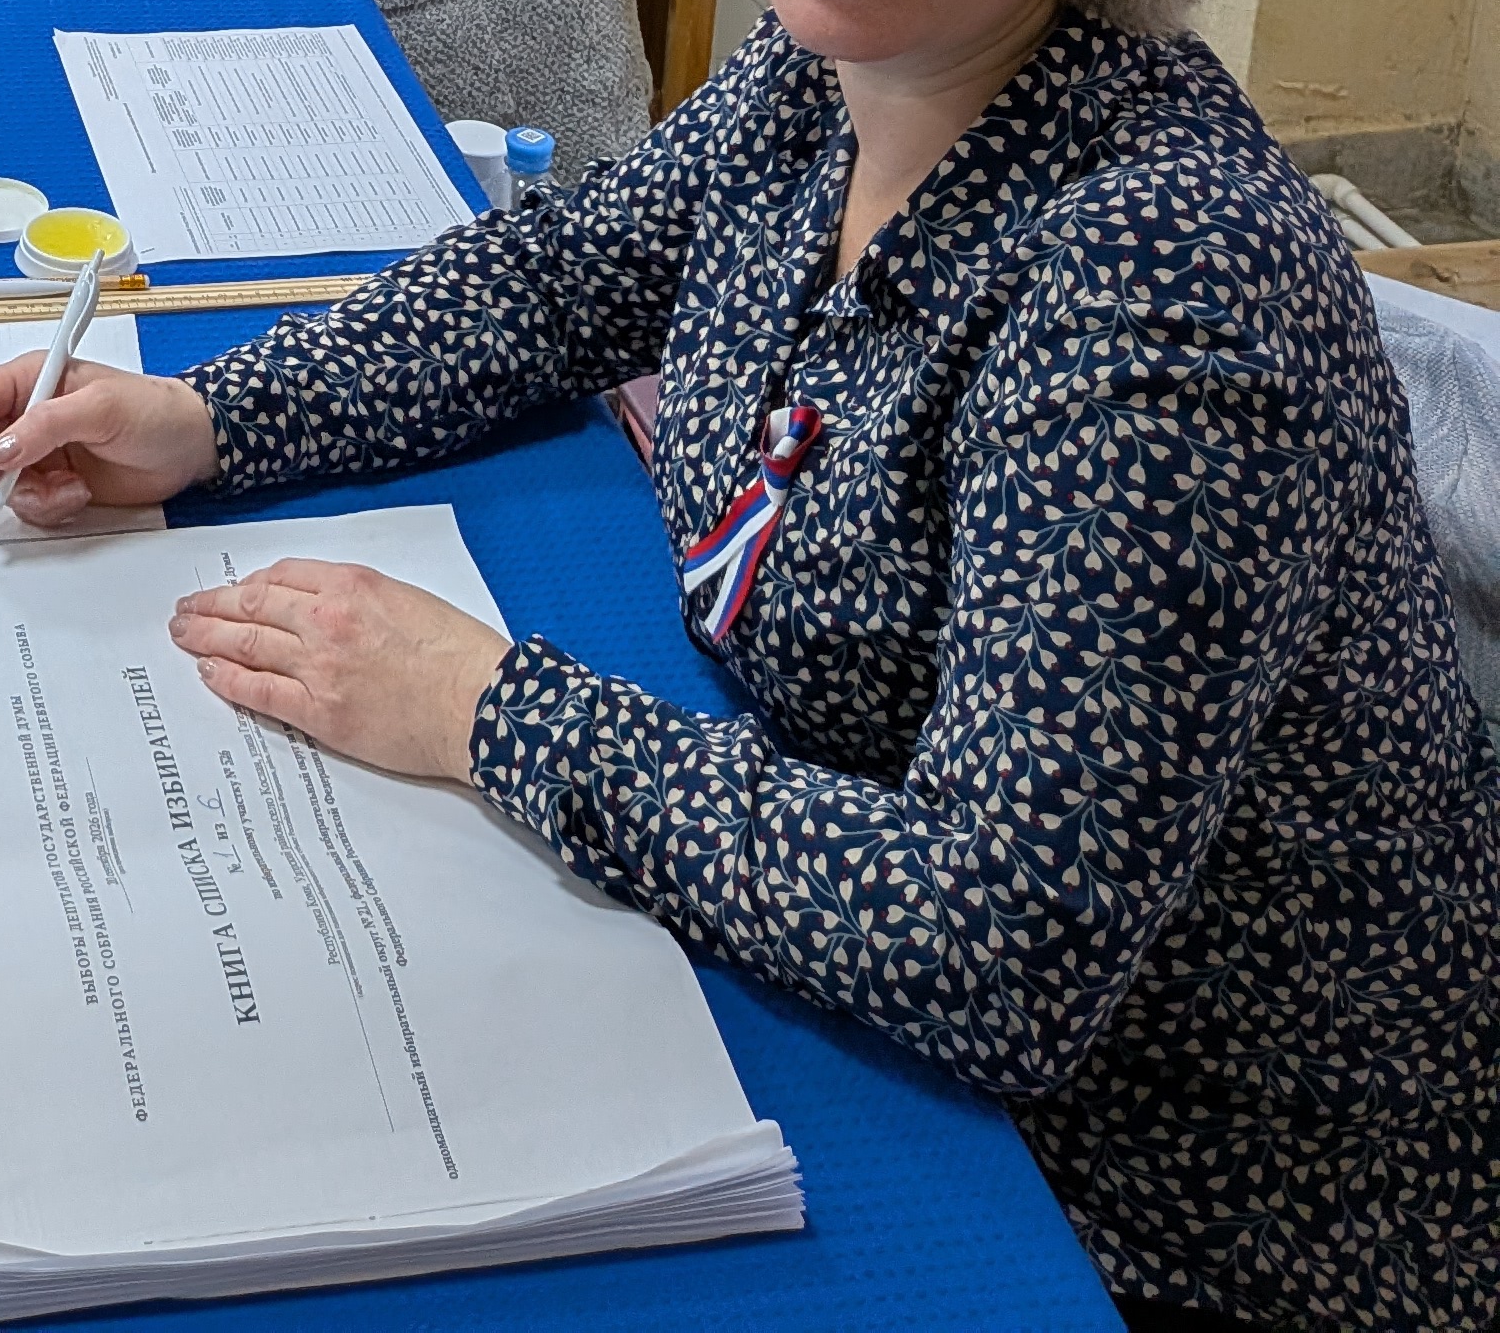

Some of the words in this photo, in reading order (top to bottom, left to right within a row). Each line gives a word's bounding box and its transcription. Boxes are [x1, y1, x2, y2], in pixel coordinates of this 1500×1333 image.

[219, 552, 239, 577] Думы
[13, 624, 35, 669] СОЗЫВА
[10, 695, 31, 730] ДУМЫ
[26, 672, 53, 730] ДЕВЯТОГО
[231, 701, 251, 733] Гагари
[41, 732, 71, 811] ФЕДЕРАЦИИ
[122, 665, 193, 830] ИЗБИРАТЕЛЕЙ
[288, 745, 312, 772] округ
[222, 767, 237, 779] №
[252, 759, 270, 795] Кослан,
[310, 751, 337, 806] Федерации
[18, 733, 62, 869] ГОСУДАРСТВЕННОЙ
[84, 792, 100, 814] года
[197, 794, 223, 810] 6
[230, 781, 254, 827] участку
[298, 772, 337, 850] избирательный
[87, 817, 103, 842] 2026
[214, 823, 230, 841] из
[327, 807, 358, 859] Российской
[58, 817, 96, 894] РОССИЙСКОЙ
[178, 838, 227, 916] СПИСКА
[212, 851, 234, 859] 1
[227, 862, 245, 874] №
[352, 860, 377, 896] Собрания
[51, 871, 83, 932] ДЕПУТАТОВ
[301, 884, 320, 908] Коми,
[87, 897, 116, 969] СОБРАНИЯ
[311, 909, 340, 965] Республика
[360, 918, 376, 929] №
[368, 931, 390, 962] округ
[374, 897, 408, 967] Федерального
[72, 936, 99, 1005] ВЫБОРЫ
[212, 923, 261, 1025] КНИГА
[378, 965, 423, 1068] избирательный
[106, 975, 150, 1123] ФЕДЕРАЛЬНОГО
[411, 1070, 460, 1180] одномандатный
